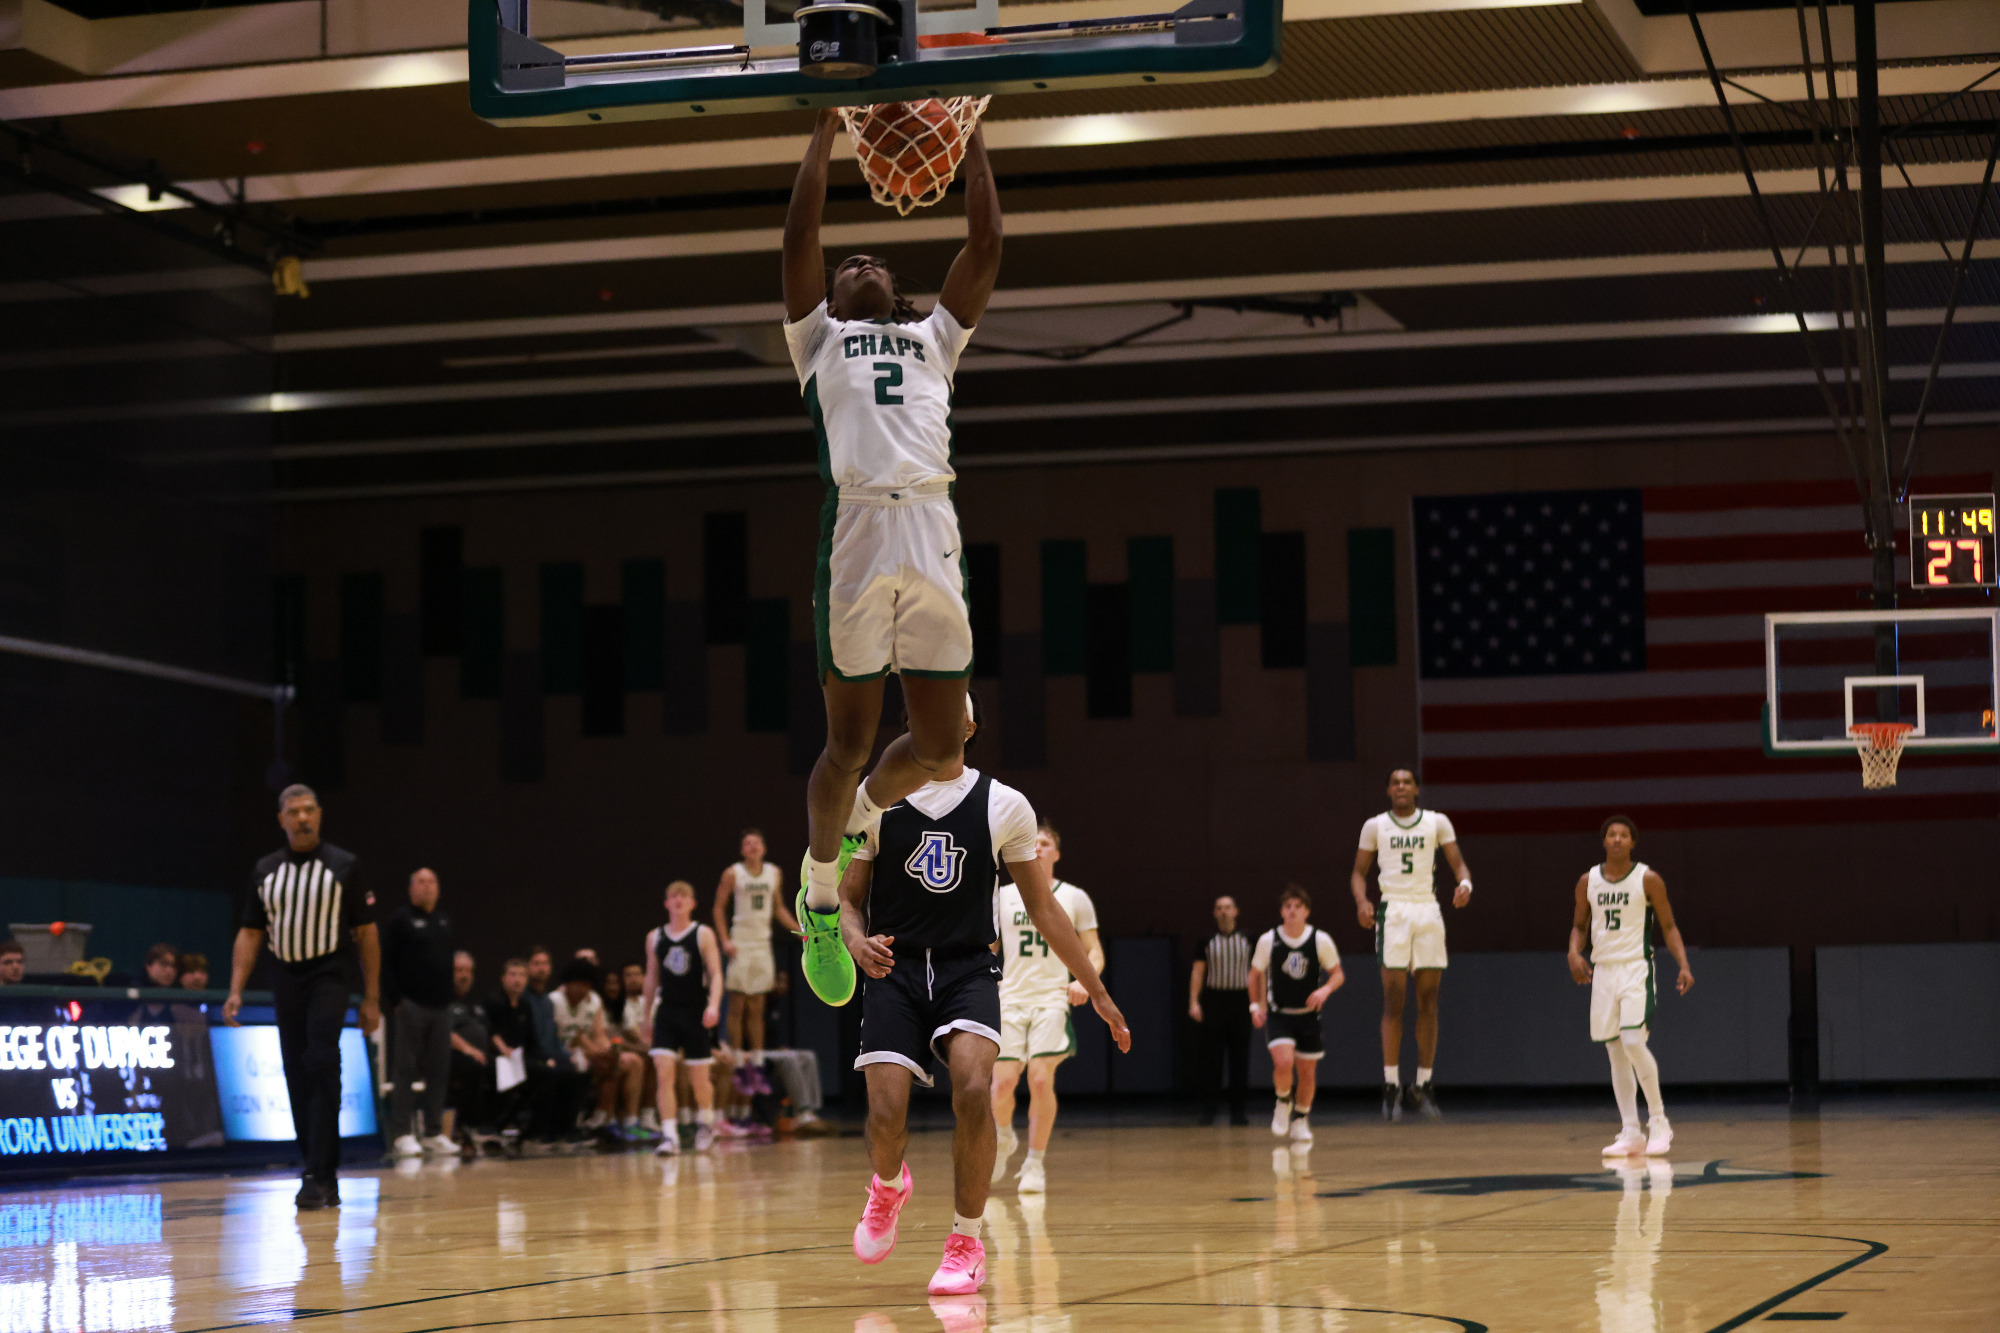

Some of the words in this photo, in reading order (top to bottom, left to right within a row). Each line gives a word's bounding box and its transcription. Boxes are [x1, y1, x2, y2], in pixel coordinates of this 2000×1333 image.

[844, 334, 926, 362] CHAPS
[873, 362, 904, 405] 2
[1921, 509, 1993, 536] 11:49
[1927, 539, 1982, 585] 27
[1390, 836, 1425, 849] CHAPS
[908, 834, 960, 889] AU
[1401, 852, 1413, 874] 5
[1597, 892, 1629, 906] CHAPS
[1604, 908, 1622, 930] 15
[1019, 930, 1048, 957] 24
[46, 1026, 80, 1069] OF
[81, 1026, 175, 1069] DUPAGE
[51, 1078, 78, 1110] VS
[51, 1112, 165, 1152] UNIVERSITY
